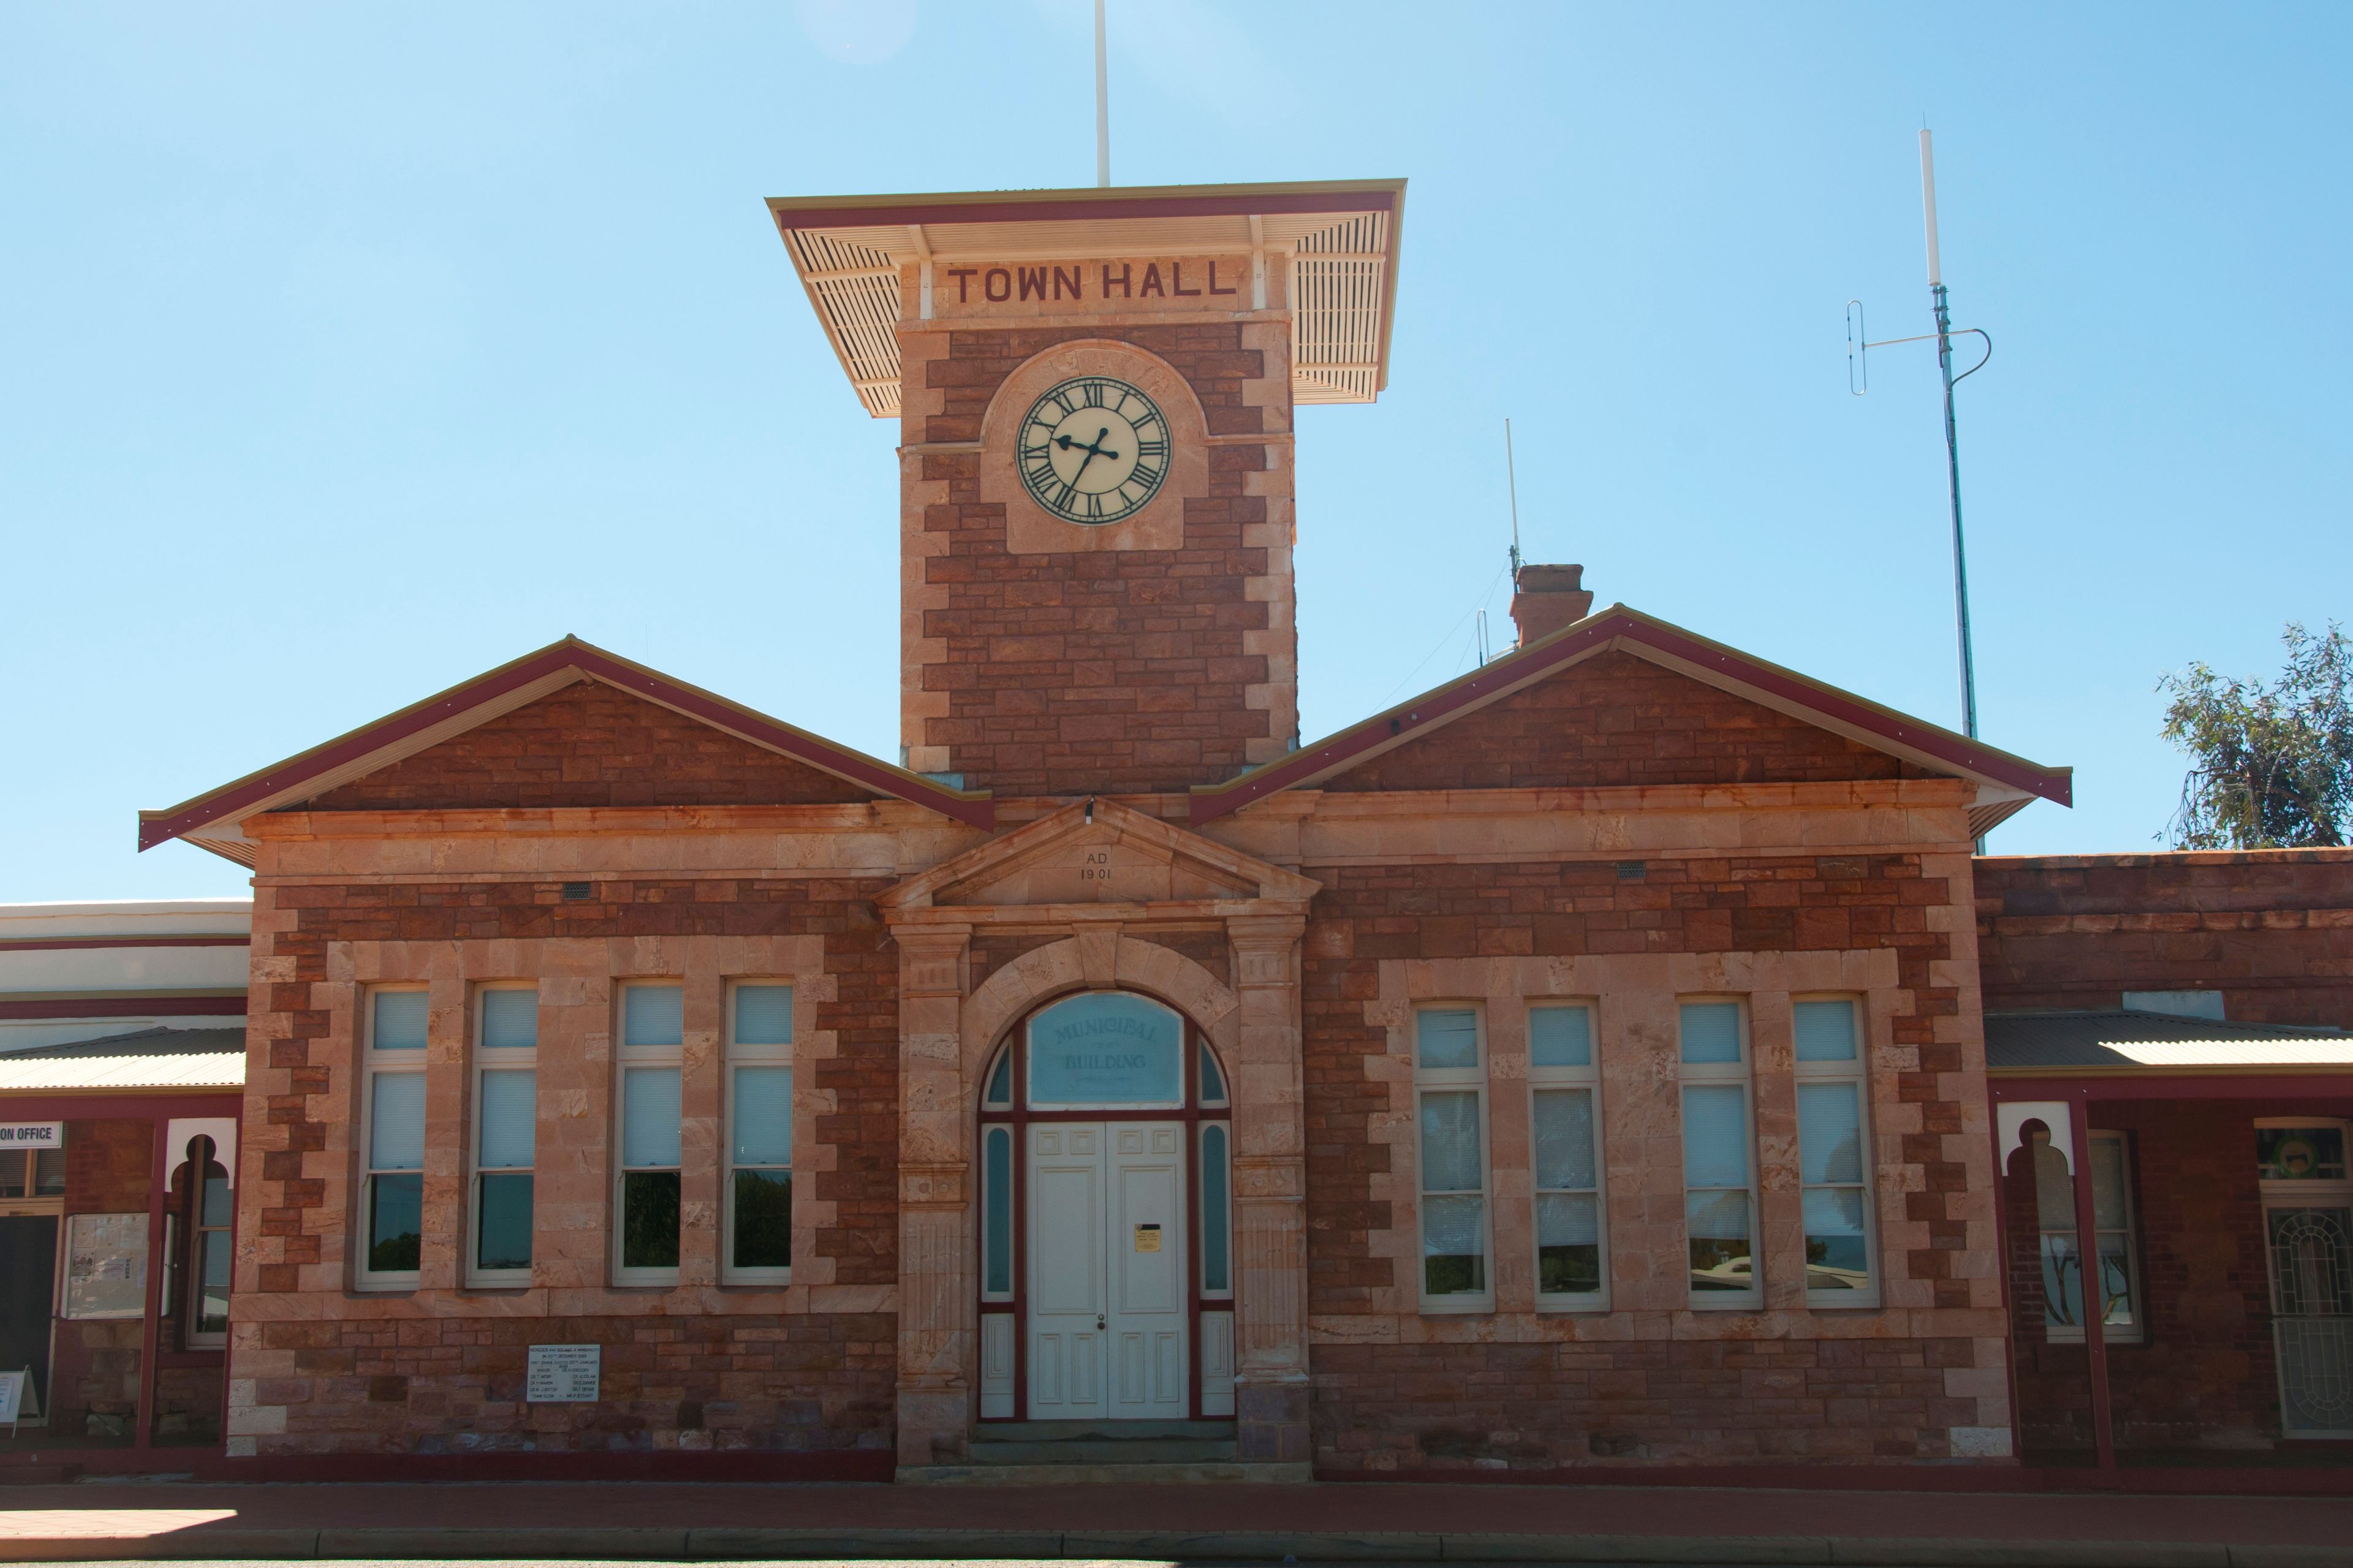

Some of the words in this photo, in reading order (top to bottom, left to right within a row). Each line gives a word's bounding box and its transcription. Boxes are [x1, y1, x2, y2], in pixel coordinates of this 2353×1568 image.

[948, 265, 1081, 303] TOWN
[1102, 260, 1237, 298] HALL
[1083, 385, 1103, 407] XII
[1051, 392, 1076, 419] XI
[1033, 417, 1057, 434] X
[1131, 412, 1155, 430] II
[1025, 444, 1050, 459] IX
[1139, 441, 1164, 455] III
[1054, 1017, 1157, 1045] MUNICIPAL
[1065, 1054, 1146, 1069] BUILDING
[17, 1127, 52, 1140] OFFICE
